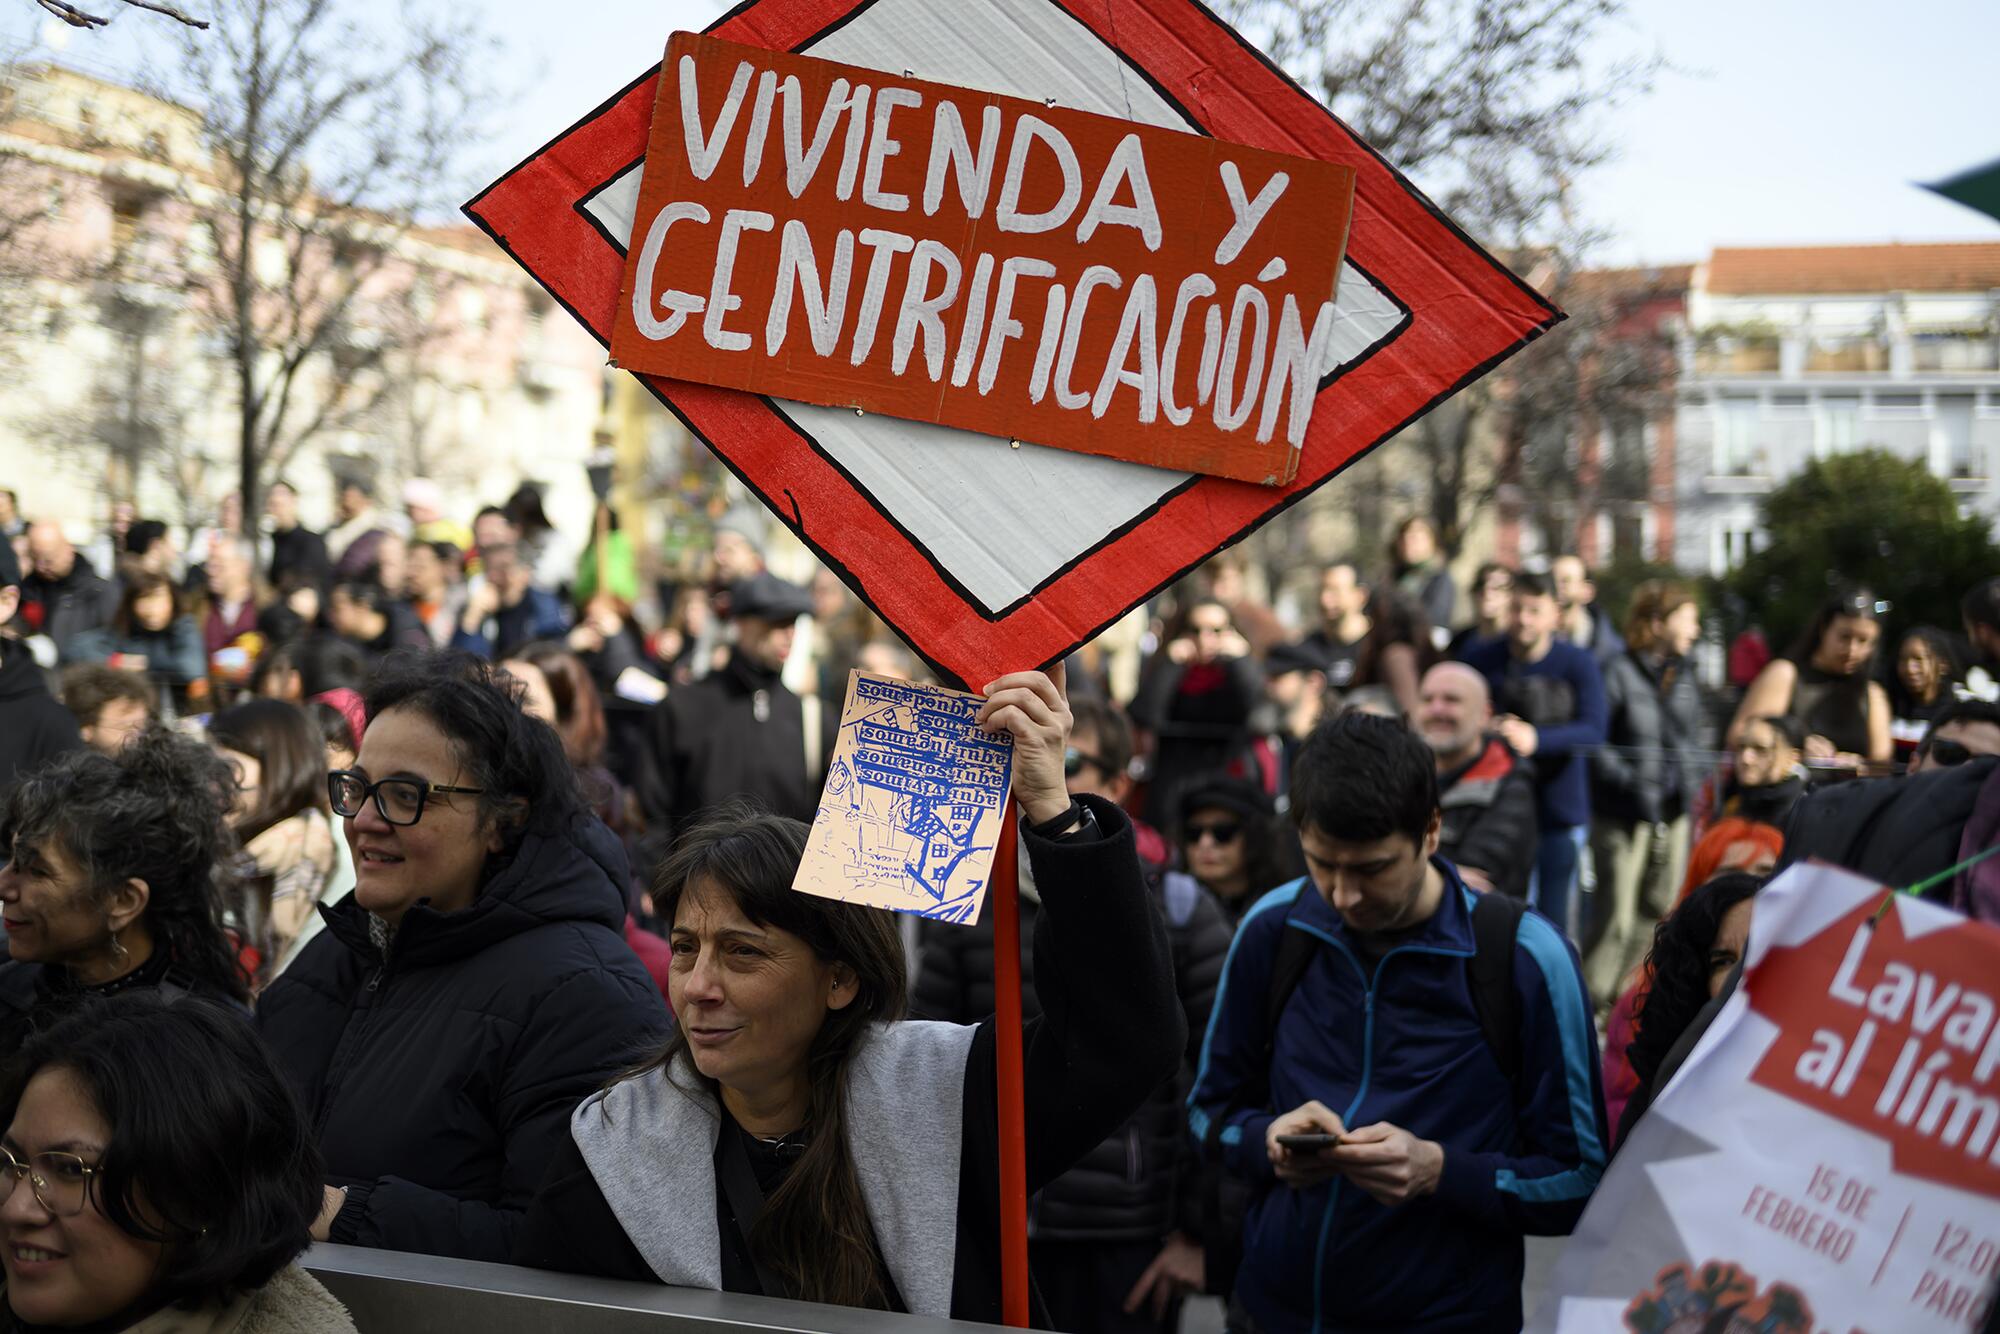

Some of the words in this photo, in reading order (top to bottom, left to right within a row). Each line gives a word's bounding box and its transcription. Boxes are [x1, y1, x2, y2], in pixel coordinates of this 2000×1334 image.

[679, 54, 1162, 252] VIVIENDA
[1215, 160, 1290, 264] Y
[631, 201, 1337, 448] GENTRIFICACIÓN
[1795, 1018, 1878, 1098] al
[1873, 1037, 2000, 1167] lím
[1741, 1184, 1857, 1265] FEBRERO
[1805, 1163, 1839, 1204] 15
[1836, 1178, 1879, 1222] DE
